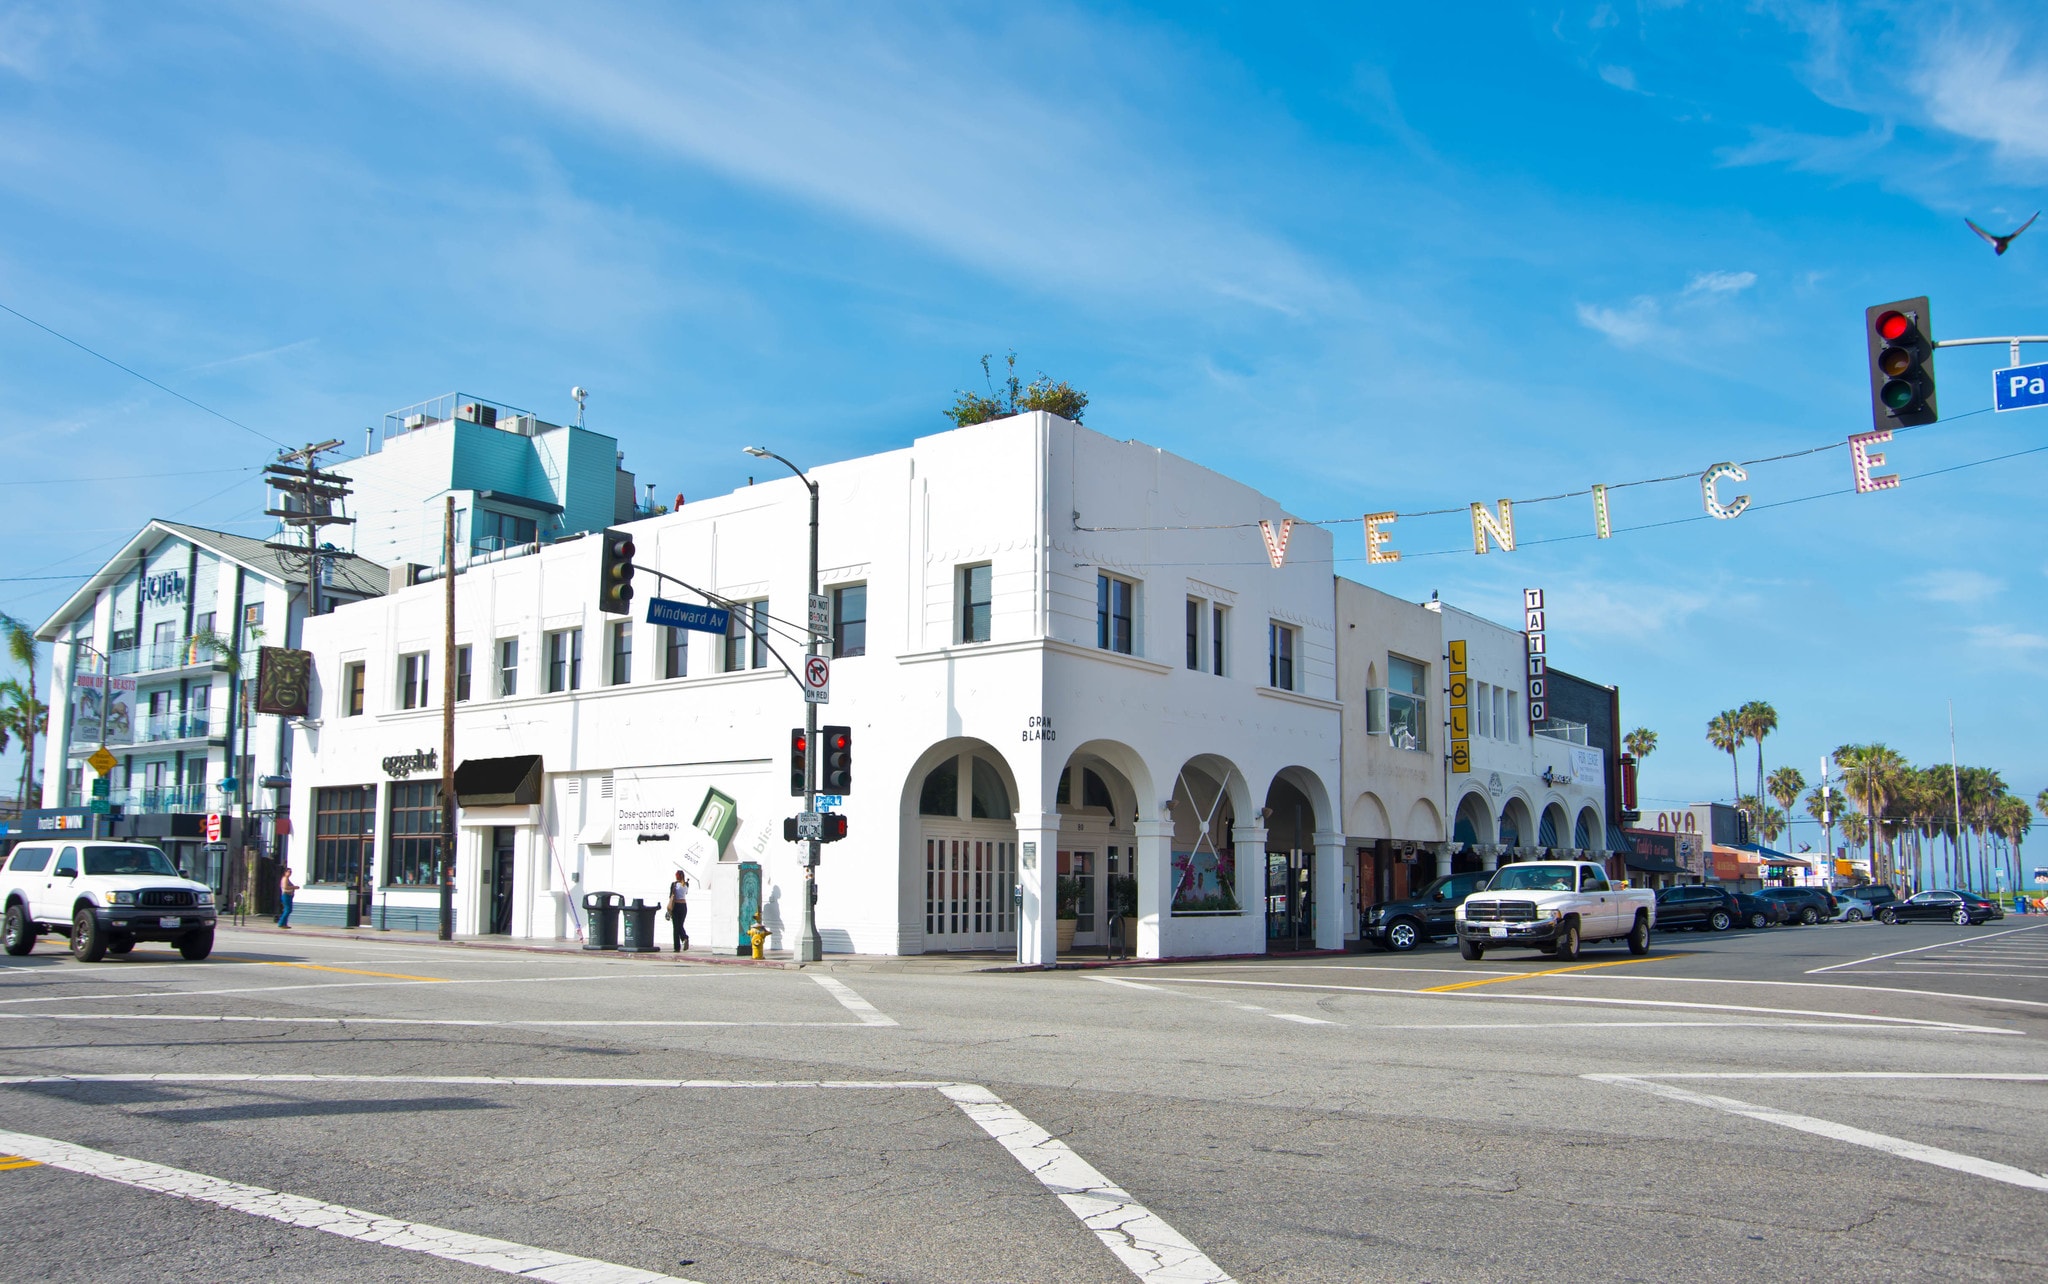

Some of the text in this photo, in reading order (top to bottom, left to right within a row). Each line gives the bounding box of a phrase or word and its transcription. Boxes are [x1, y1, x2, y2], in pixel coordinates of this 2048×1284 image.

[2010, 375, 2045, 398] Pa
[1259, 430, 1900, 568] VENICE
[140, 570, 184, 602] HOTEL
[809, 598, 828, 610] DO NOT
[654, 603, 724, 627] Windward Av
[1528, 591, 1543, 719] TATTOO
[77, 675, 136, 691] BOOK OF BEASTS
[806, 689, 828, 700] ON RED
[1028, 715, 1052, 728] GRAN
[1022, 729, 1056, 742] BLANCO
[382, 747, 438, 779] eggslut
[619, 808, 675, 819] Dose-controlled
[618, 819, 680, 832] cannabis therapy.
[799, 825, 808, 835] OK
[1657, 811, 1696, 834] AYA
